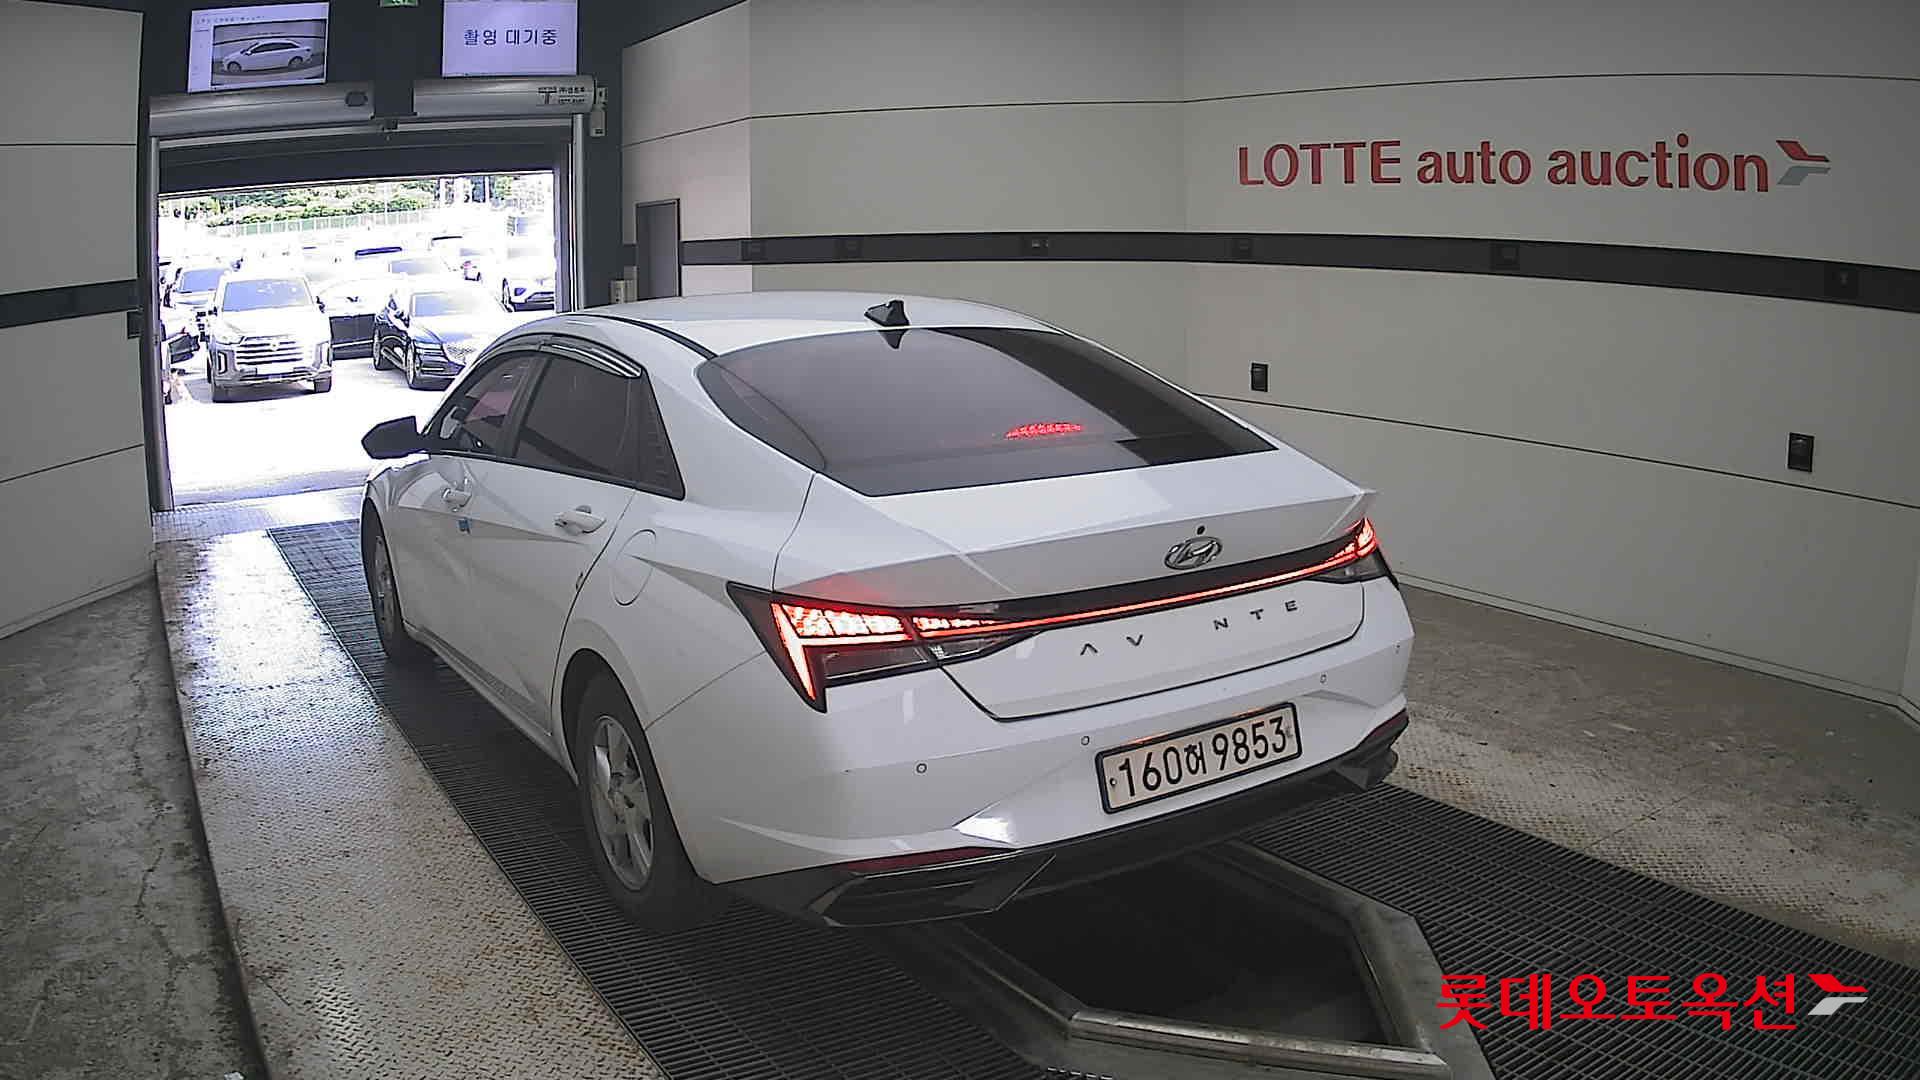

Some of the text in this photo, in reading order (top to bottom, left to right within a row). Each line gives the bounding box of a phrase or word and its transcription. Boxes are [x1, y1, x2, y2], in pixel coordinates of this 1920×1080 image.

[464, 28, 558, 46] 촬영 대기중
[1238, 133, 1769, 193] LOTTE auto auction
